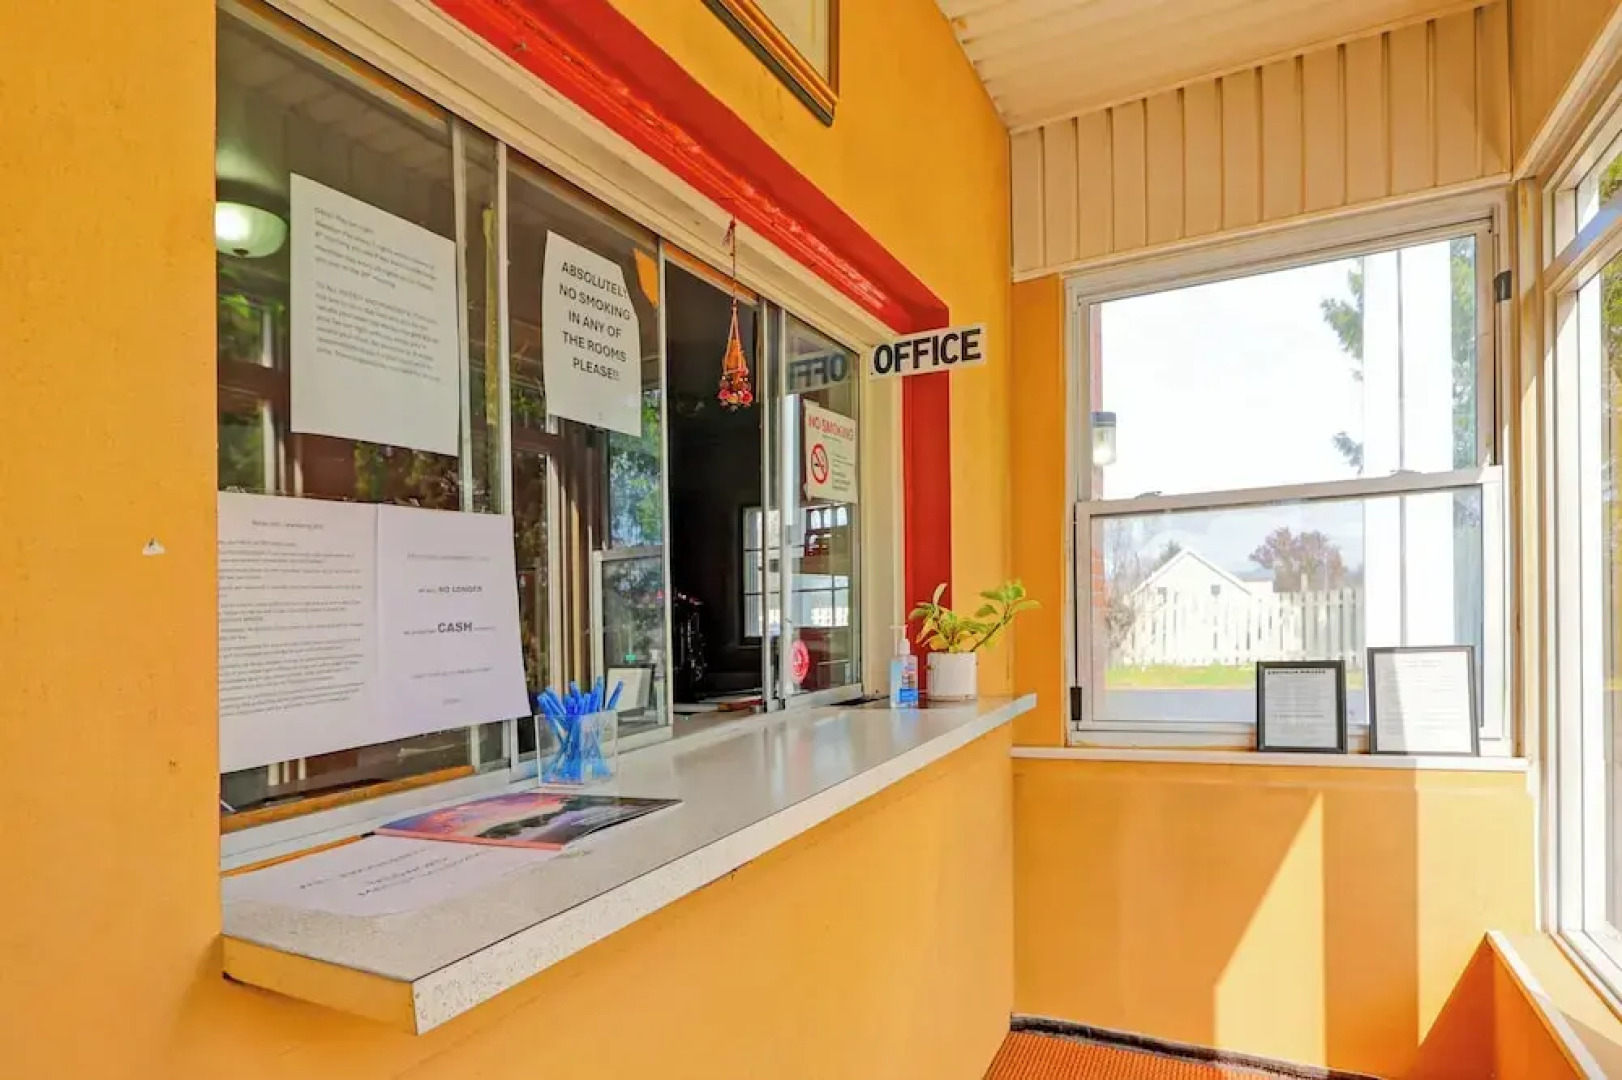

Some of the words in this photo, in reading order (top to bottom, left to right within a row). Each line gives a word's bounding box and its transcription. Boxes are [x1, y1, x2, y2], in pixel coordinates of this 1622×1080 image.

[561, 261, 628, 298] ABSOLUTELY
[559, 284, 577, 300] NO
[579, 292, 631, 321] SMOKING
[568, 310, 580, 325] IN
[581, 316, 606, 333] ANY
[607, 325, 622, 338] OF
[562, 331, 585, 350] THE
[586, 340, 628, 363] ROOMS
[873, 328, 982, 374] OFFICE
[808, 415, 821, 430] NO
[437, 622, 474, 633] CASH
